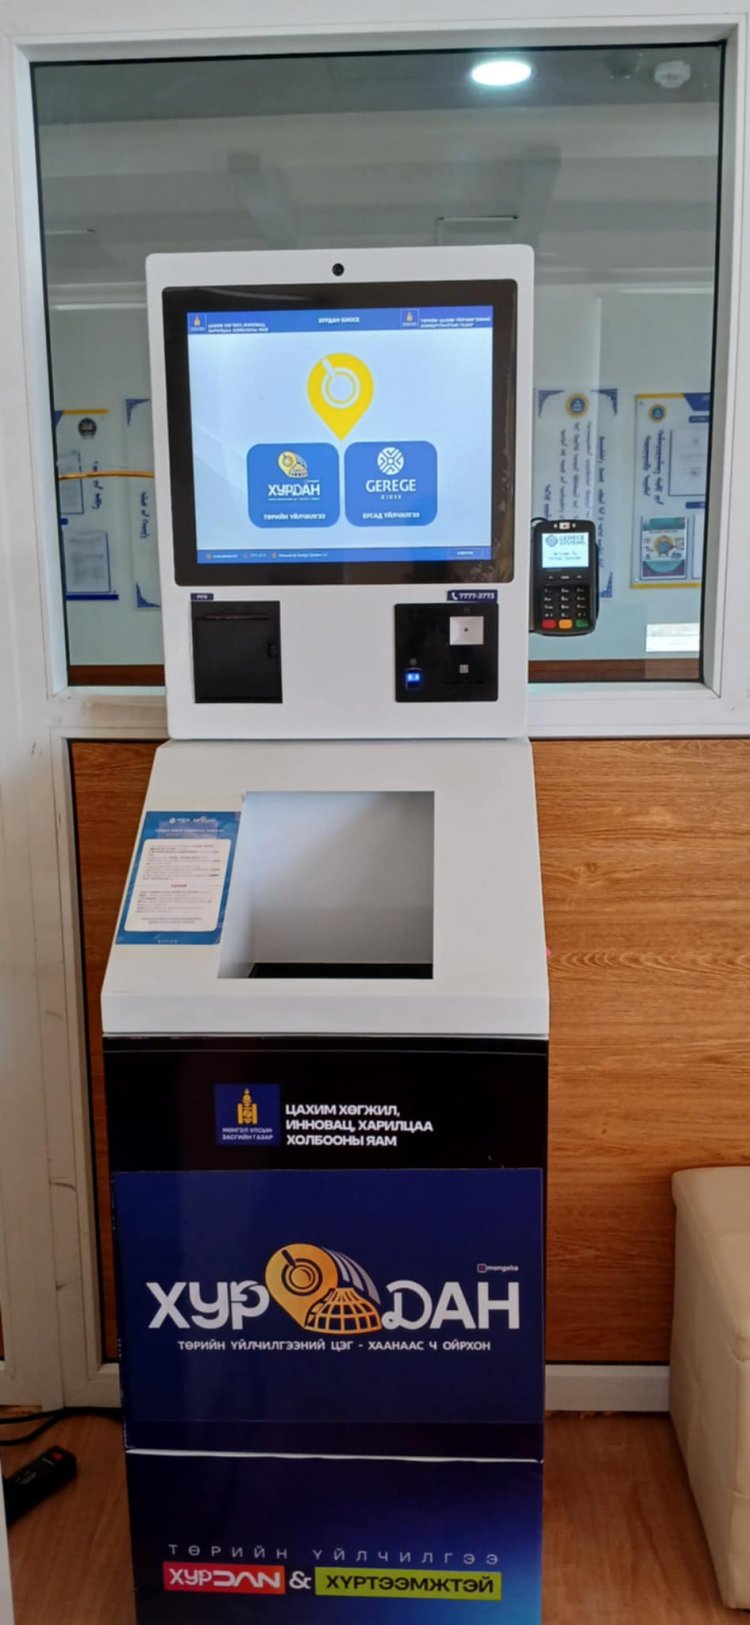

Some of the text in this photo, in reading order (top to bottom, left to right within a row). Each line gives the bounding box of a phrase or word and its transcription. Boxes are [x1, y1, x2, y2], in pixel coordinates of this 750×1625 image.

[268, 483, 320, 496] ХУРДАН
[365, 479, 416, 493] GEREGE
[285, 1104, 401, 1117] ЦАХИМ ХӨГЖИЛ,
[285, 1119, 434, 1133] ИННОВАЦ, ХАРИЛЦАА
[222, 1133, 251, 1141] ЗАСГИЙН
[286, 1134, 397, 1147] ХОЛБООНЫ ЯАМ
[178, 1340, 226, 1351] ТӨРИЙН
[230, 1339, 326, 1351] ҮЙЛЧИЛГЭЭНИЙ
[330, 1341, 353, 1352] ЦЭГ
[368, 1341, 424, 1351] ХААНААС
[429, 1341, 438, 1351] Ч
[443, 1340, 491, 1351] ОЙРХОН
[168, 1544, 499, 1565] ТӨРИЙН ҮЙЛЧИЛГЭЭ
[288, 1570, 312, 1589] &
[325, 1575, 494, 1594] ХҮРТЭЭМЖТЭЙ
